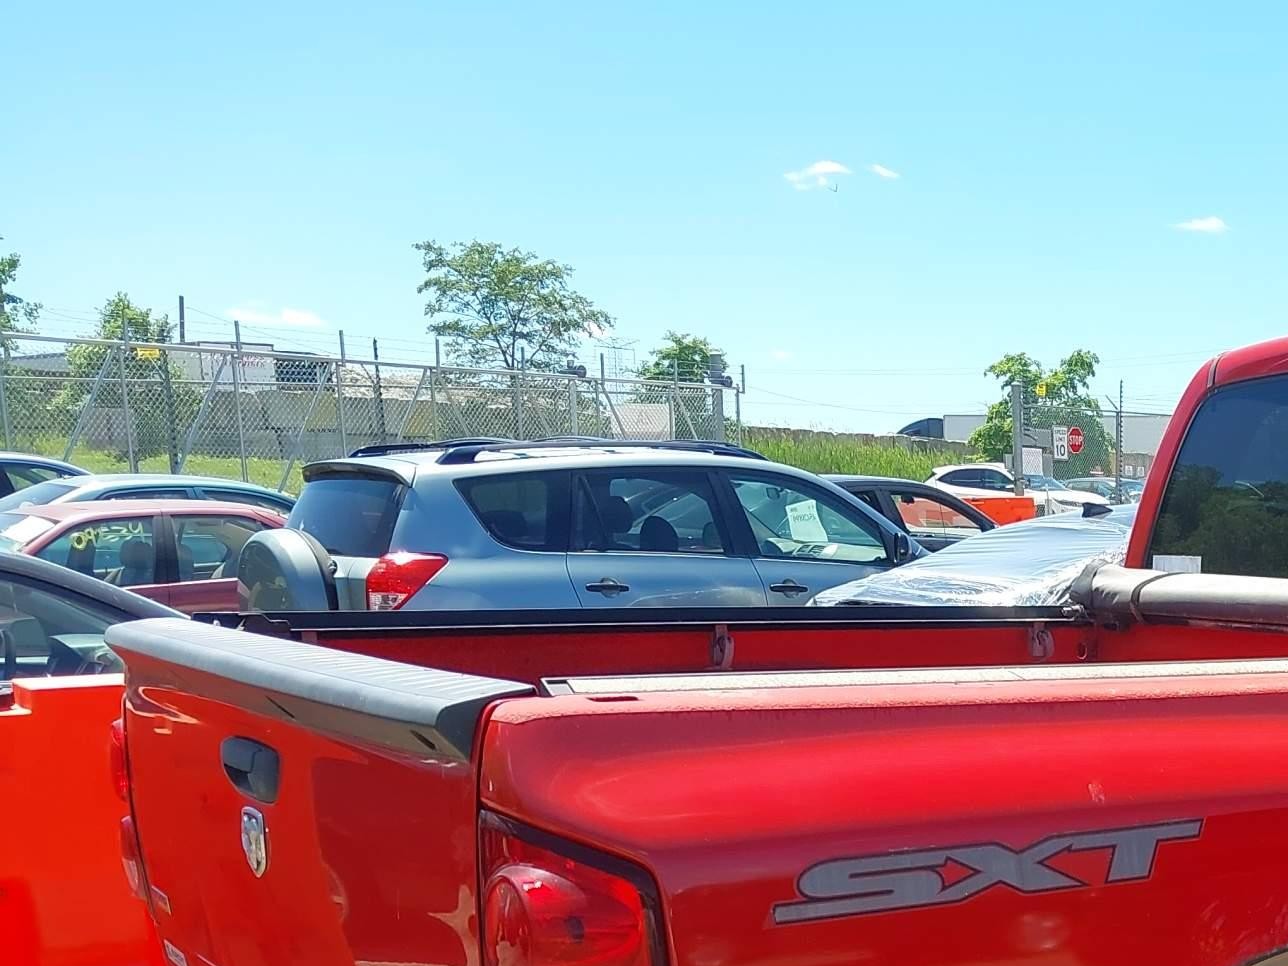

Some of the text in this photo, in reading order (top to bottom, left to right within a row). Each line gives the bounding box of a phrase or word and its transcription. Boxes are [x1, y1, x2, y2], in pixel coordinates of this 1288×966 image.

[1069, 435, 1083, 445] STOP
[1056, 445, 1065, 457] 10
[771, 818, 1204, 925] SXT
